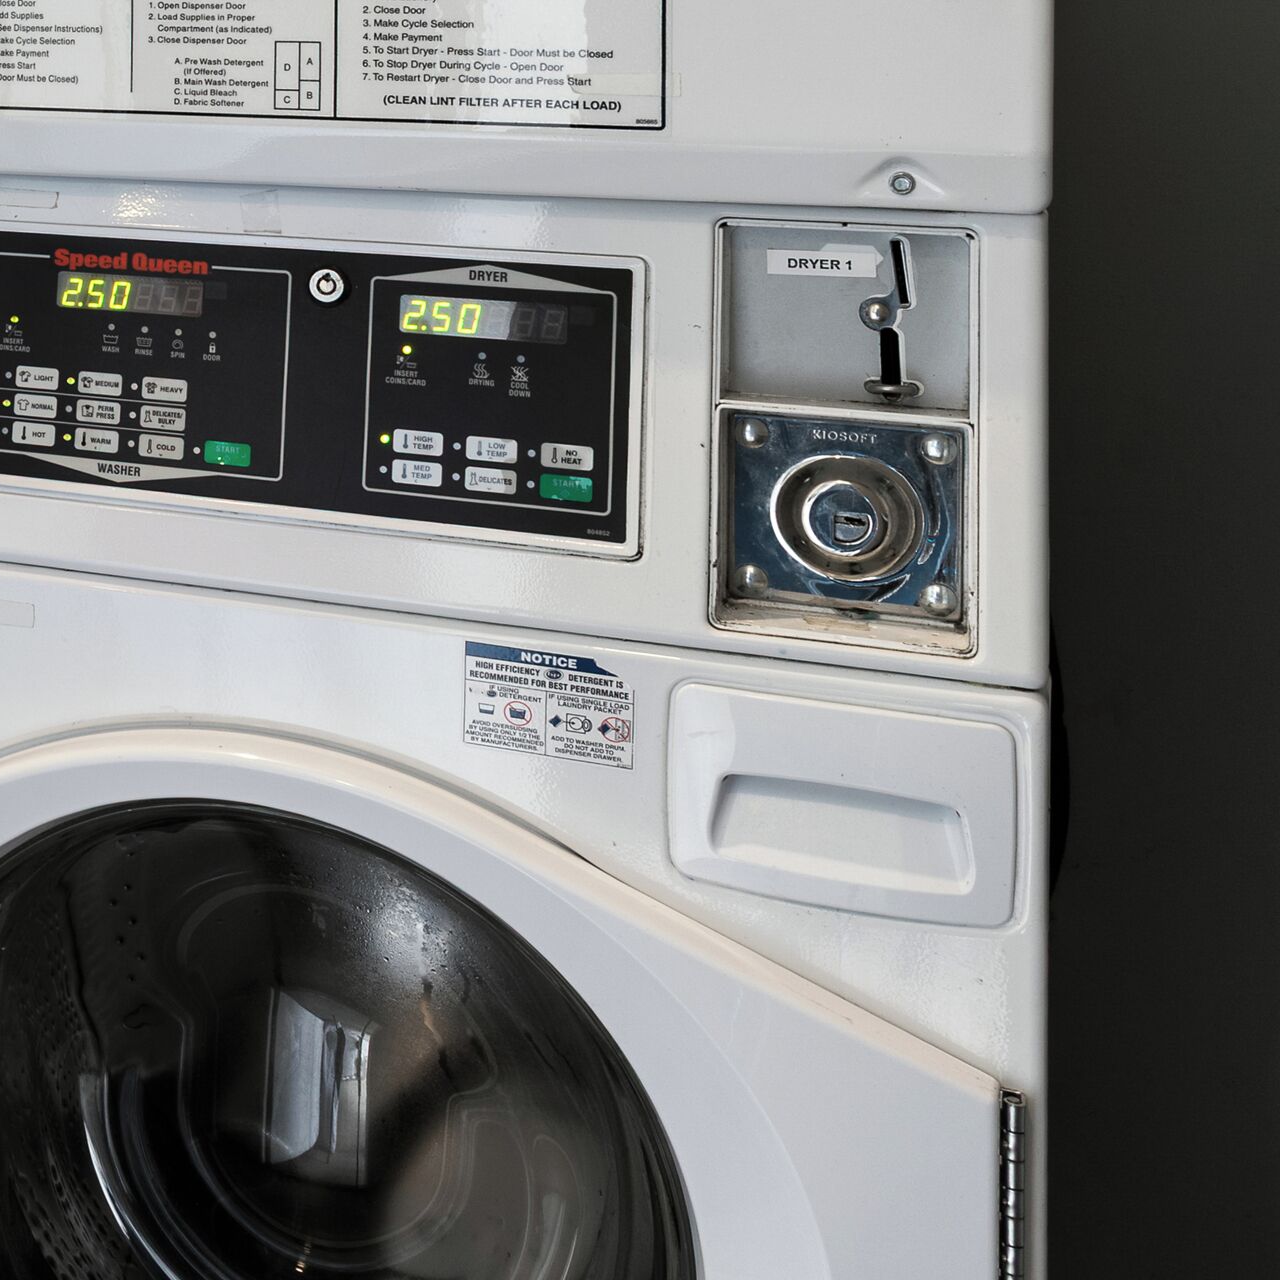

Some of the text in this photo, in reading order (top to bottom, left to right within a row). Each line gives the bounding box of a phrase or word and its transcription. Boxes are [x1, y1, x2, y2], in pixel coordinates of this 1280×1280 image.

[374, 6, 400, 14] Close
[11, 12, 44, 21] Supplies
[402, 20, 427, 29] Cycle
[431, 20, 474, 28] Selection
[14, 25, 52, 33] Dispenser
[54, 25, 103, 34] Instructions)
[16, 37, 37, 46] Cycle
[402, 34, 442, 43] Payment
[16, 50, 49, 58] Payment
[48, 75, 78, 84] Closed)
[383, 95, 621, 112] (CLEAN LINT FILTER AFTER EACH LOAD)
[54, 249, 208, 275] Speed Queen
[788, 257, 852, 270] DRYER 1
[469, 271, 508, 283] DRYER
[61, 277, 131, 310] 2.50
[402, 300, 481, 335] 2.50
[170, 351, 185, 359] SPIN
[95, 380, 119, 388] MEDIUM
[469, 378, 494, 387] DRYING
[160, 386, 183, 394] HEAVY
[509, 389, 530, 398] DOWN
[31, 403, 54, 411] NORMAL
[98, 405, 114, 413] PERM
[96, 412, 115, 420] PRESS
[152, 410, 183, 419] DELICATES/
[414, 435, 433, 443] HIGH
[813, 429, 878, 444] KIOSOFT
[216, 445, 239, 454] START
[413, 443, 434, 451] TEMP
[486, 450, 508, 458] TEMP
[566, 449, 578, 457] NO
[561, 457, 582, 465] HEAT
[97, 463, 141, 477] WASHER
[412, 472, 432, 480] TEMP
[478, 476, 513, 487] DELICATES
[552, 479, 581, 488] START
[521, 651, 577, 668] NOTICE
[475, 661, 493, 669] HIGH
[496, 663, 540, 676] EFFICIENCY
[569, 674, 614, 687] DETERGENT
[470, 671, 629, 700] RECOMMENDED FOR BEST PERFORMANCE
